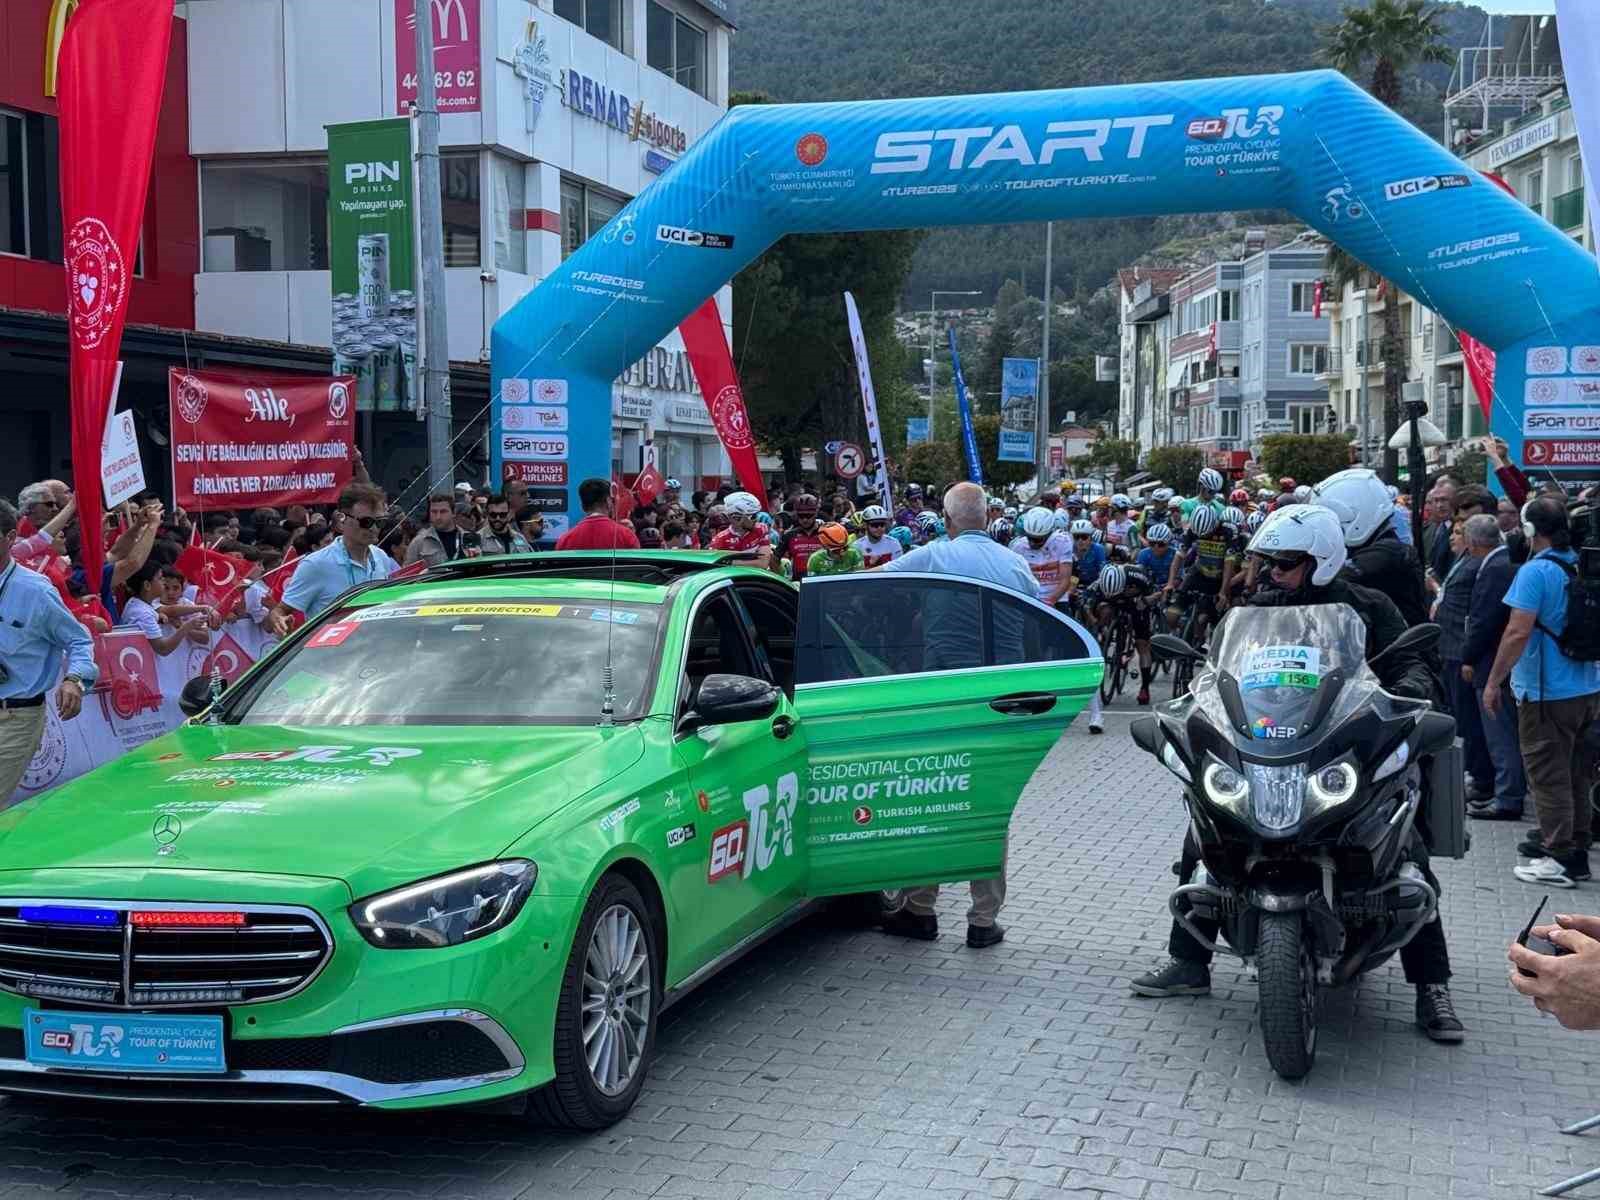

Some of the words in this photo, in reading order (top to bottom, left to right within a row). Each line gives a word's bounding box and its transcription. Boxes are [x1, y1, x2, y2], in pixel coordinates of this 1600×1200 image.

[457, 70, 475, 87] 62
[569, 68, 630, 132] RENAR
[646, 112, 687, 152] sigorta
[869, 113, 1175, 174] START
[1184, 141, 1243, 154] PRESIDENTIAL
[1184, 155, 1214, 167] TOUR
[1216, 154, 1231, 165] OF
[1232, 148, 1280, 163] TÜRKİYE
[345, 160, 400, 184] PIN
[352, 184, 393, 194] DRINKS
[1389, 181, 1420, 197] UCI
[660, 227, 686, 242] UCI
[361, 246, 386, 257] PIN
[244, 387, 297, 429] Aile,
[177, 441, 205, 462] SEVGİ
[206, 444, 219, 462] VE
[265, 444, 278, 461] EN
[279, 441, 308, 464] GÜÇLÜ
[1552, 443, 1600, 452] TURKISH
[1551, 452, 1600, 462] AIRLINES
[521, 464, 563, 474] TURKISH
[193, 474, 241, 494] BİRLİKTE
[241, 476, 262, 493] HER
[262, 471, 303, 492] ZORLUĞU
[521, 474, 563, 482] AIRLINES
[437, 606, 475, 614] RACE
[476, 606, 543, 614] DIRECTOR
[315, 625, 349, 643] F
[1287, 674, 1310, 685] 156
[1265, 727, 1297, 738] NEP
[904, 752, 971, 773] CYCLING
[852, 782, 880, 800] OF
[883, 772, 971, 798] TÜRKİYE
[876, 806, 922, 818] TURKISH
[925, 801, 971, 814] AIRLINES
[710, 826, 744, 876] 60.
[129, 1026, 182, 1036] PRESIDENTIAL
[43, 1032, 72, 1047] 60.
[129, 1037, 157, 1049] TOUR
[158, 1039, 173, 1049] OF
[174, 1037, 217, 1050] TÜRKİYE
